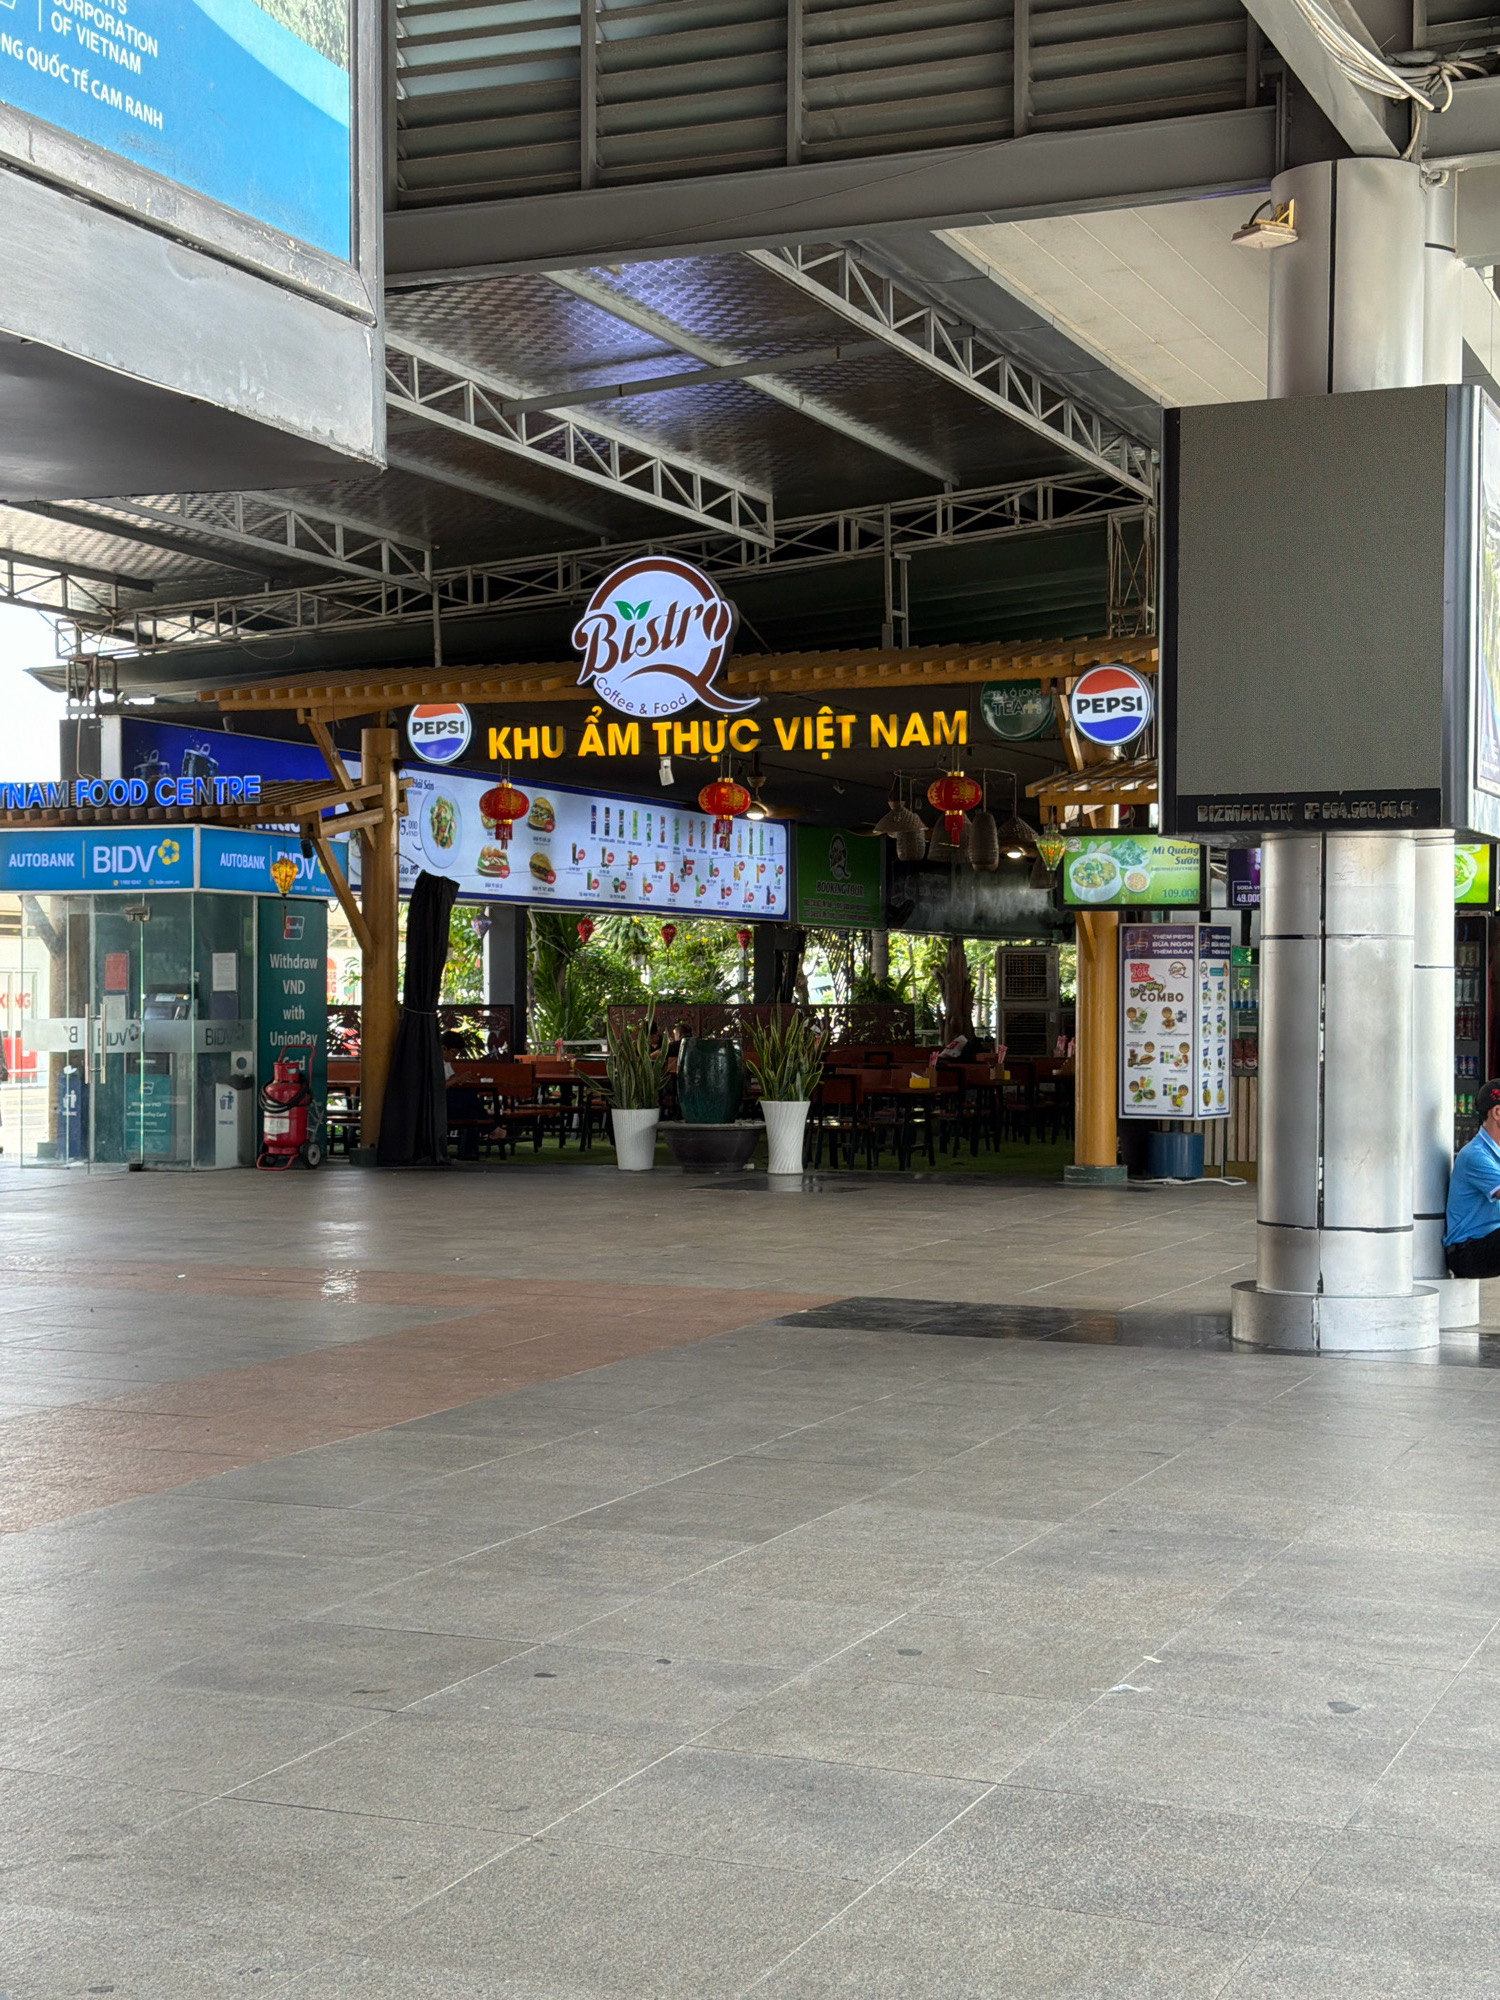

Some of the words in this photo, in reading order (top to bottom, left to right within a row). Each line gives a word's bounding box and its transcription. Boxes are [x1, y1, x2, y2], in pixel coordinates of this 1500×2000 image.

[51, 11, 72, 36] OF
[76, 23, 141, 75] VIETNAM
[26, 46, 70, 84] QUỐC
[71, 67, 89, 93] TẾ
[91, 79, 122, 110] CAM
[125, 95, 163, 130] RANH
[596, 677, 634, 711] Coffee
[639, 704, 648, 714] &
[653, 692, 688, 714] Food
[1019, 688, 1041, 698] LONG
[1076, 695, 1143, 715] PEPSI
[412, 720, 465, 736] PEPSI
[488, 725, 564, 760] KHU
[577, 705, 640, 757] ẨM
[652, 714, 760, 763] THỰC
[773, 706, 856, 760] VIỆT
[870, 710, 968, 748] NAM
[75, 778, 148, 808] FOOD
[154, 775, 262, 807] CENTRE
[1197, 803, 1295, 823] BIZMAN.VN
[9, 852, 75, 868] AUTOBANK
[93, 845, 158, 874] BIDV
[220, 852, 266, 871] AUTOBANK
[816, 881, 844, 895] BOOKING
[845, 883, 864, 897] TOUR
[1163, 888, 1199, 899] 109.000
[269, 954, 319, 970] Withdraw
[282, 980, 306, 995] VND
[1140, 992, 1185, 1003] COMBO
[282, 1005, 305, 1020] with
[269, 1030, 318, 1047] UnionPay
